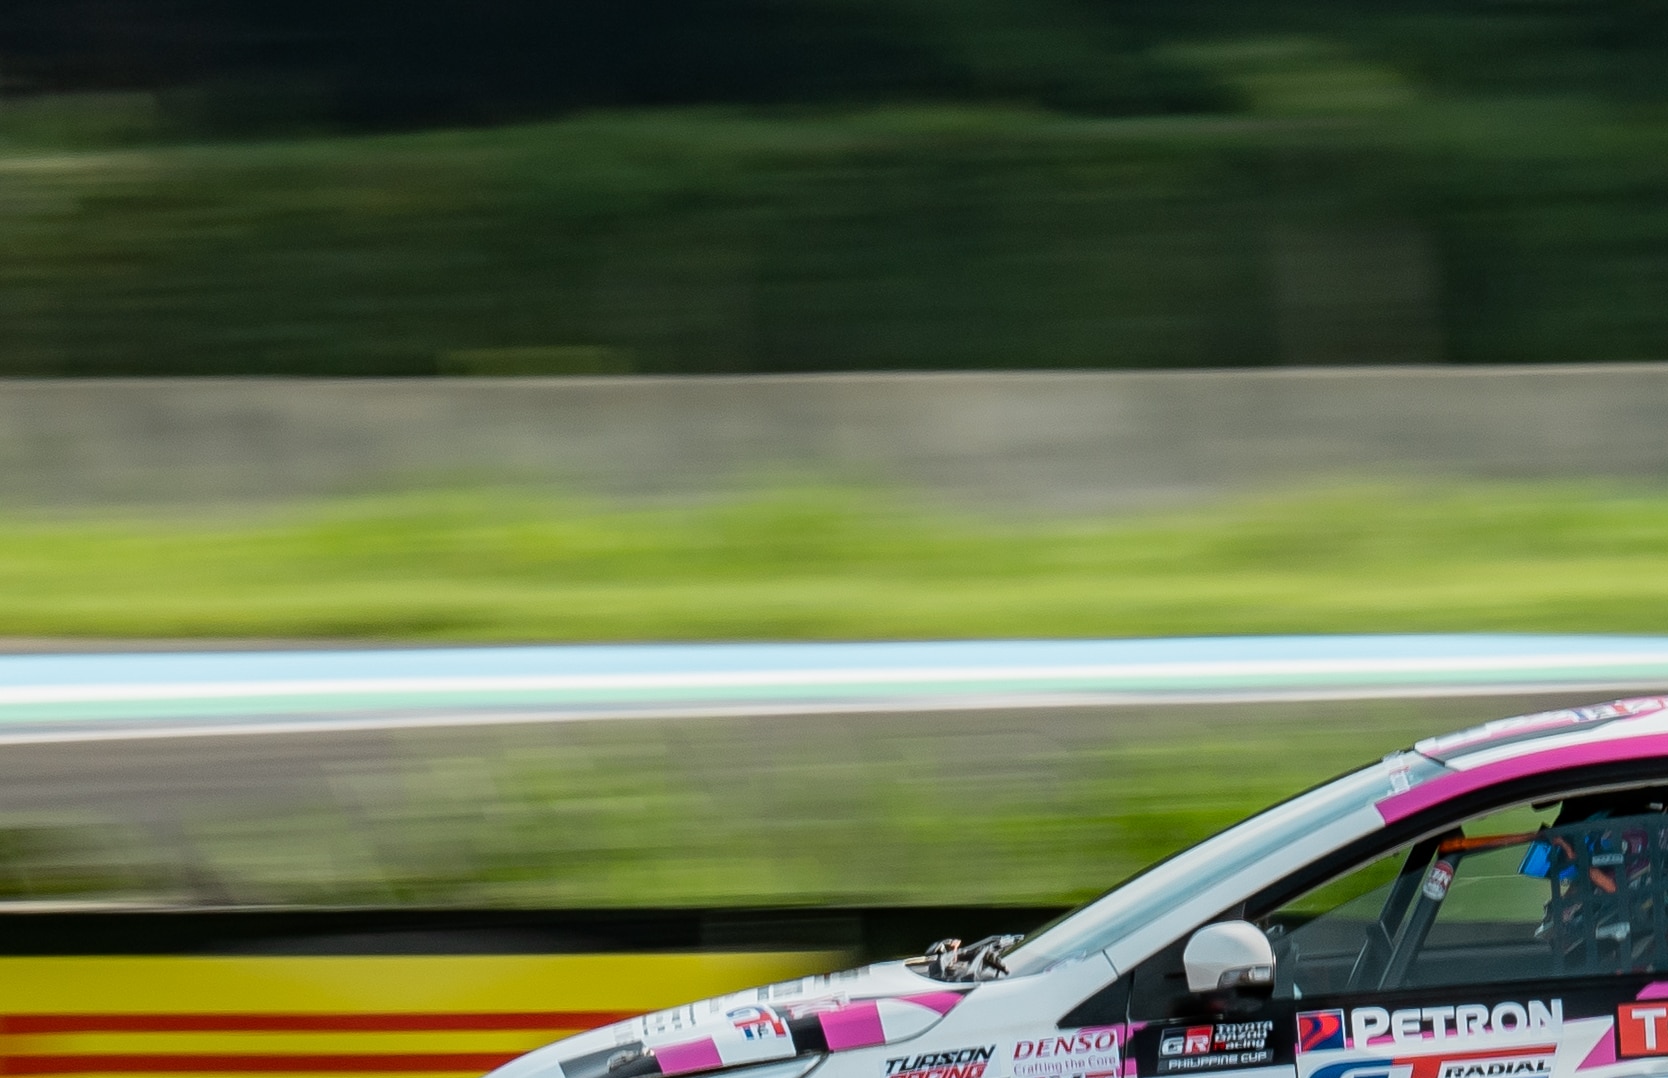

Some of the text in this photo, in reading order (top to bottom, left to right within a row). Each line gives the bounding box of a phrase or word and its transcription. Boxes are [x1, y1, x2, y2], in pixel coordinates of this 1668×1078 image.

[1216, 1020, 1273, 1035] TOYOTA
[1351, 998, 1564, 1050] PETRON
[1013, 1030, 1116, 1061] DENSO
[1161, 1035, 1210, 1056] GR
[1013, 1061, 1063, 1077] Crafting
[1064, 1058, 1086, 1069] the
[1168, 1051, 1267, 1071] PHILIPPINE CUP
